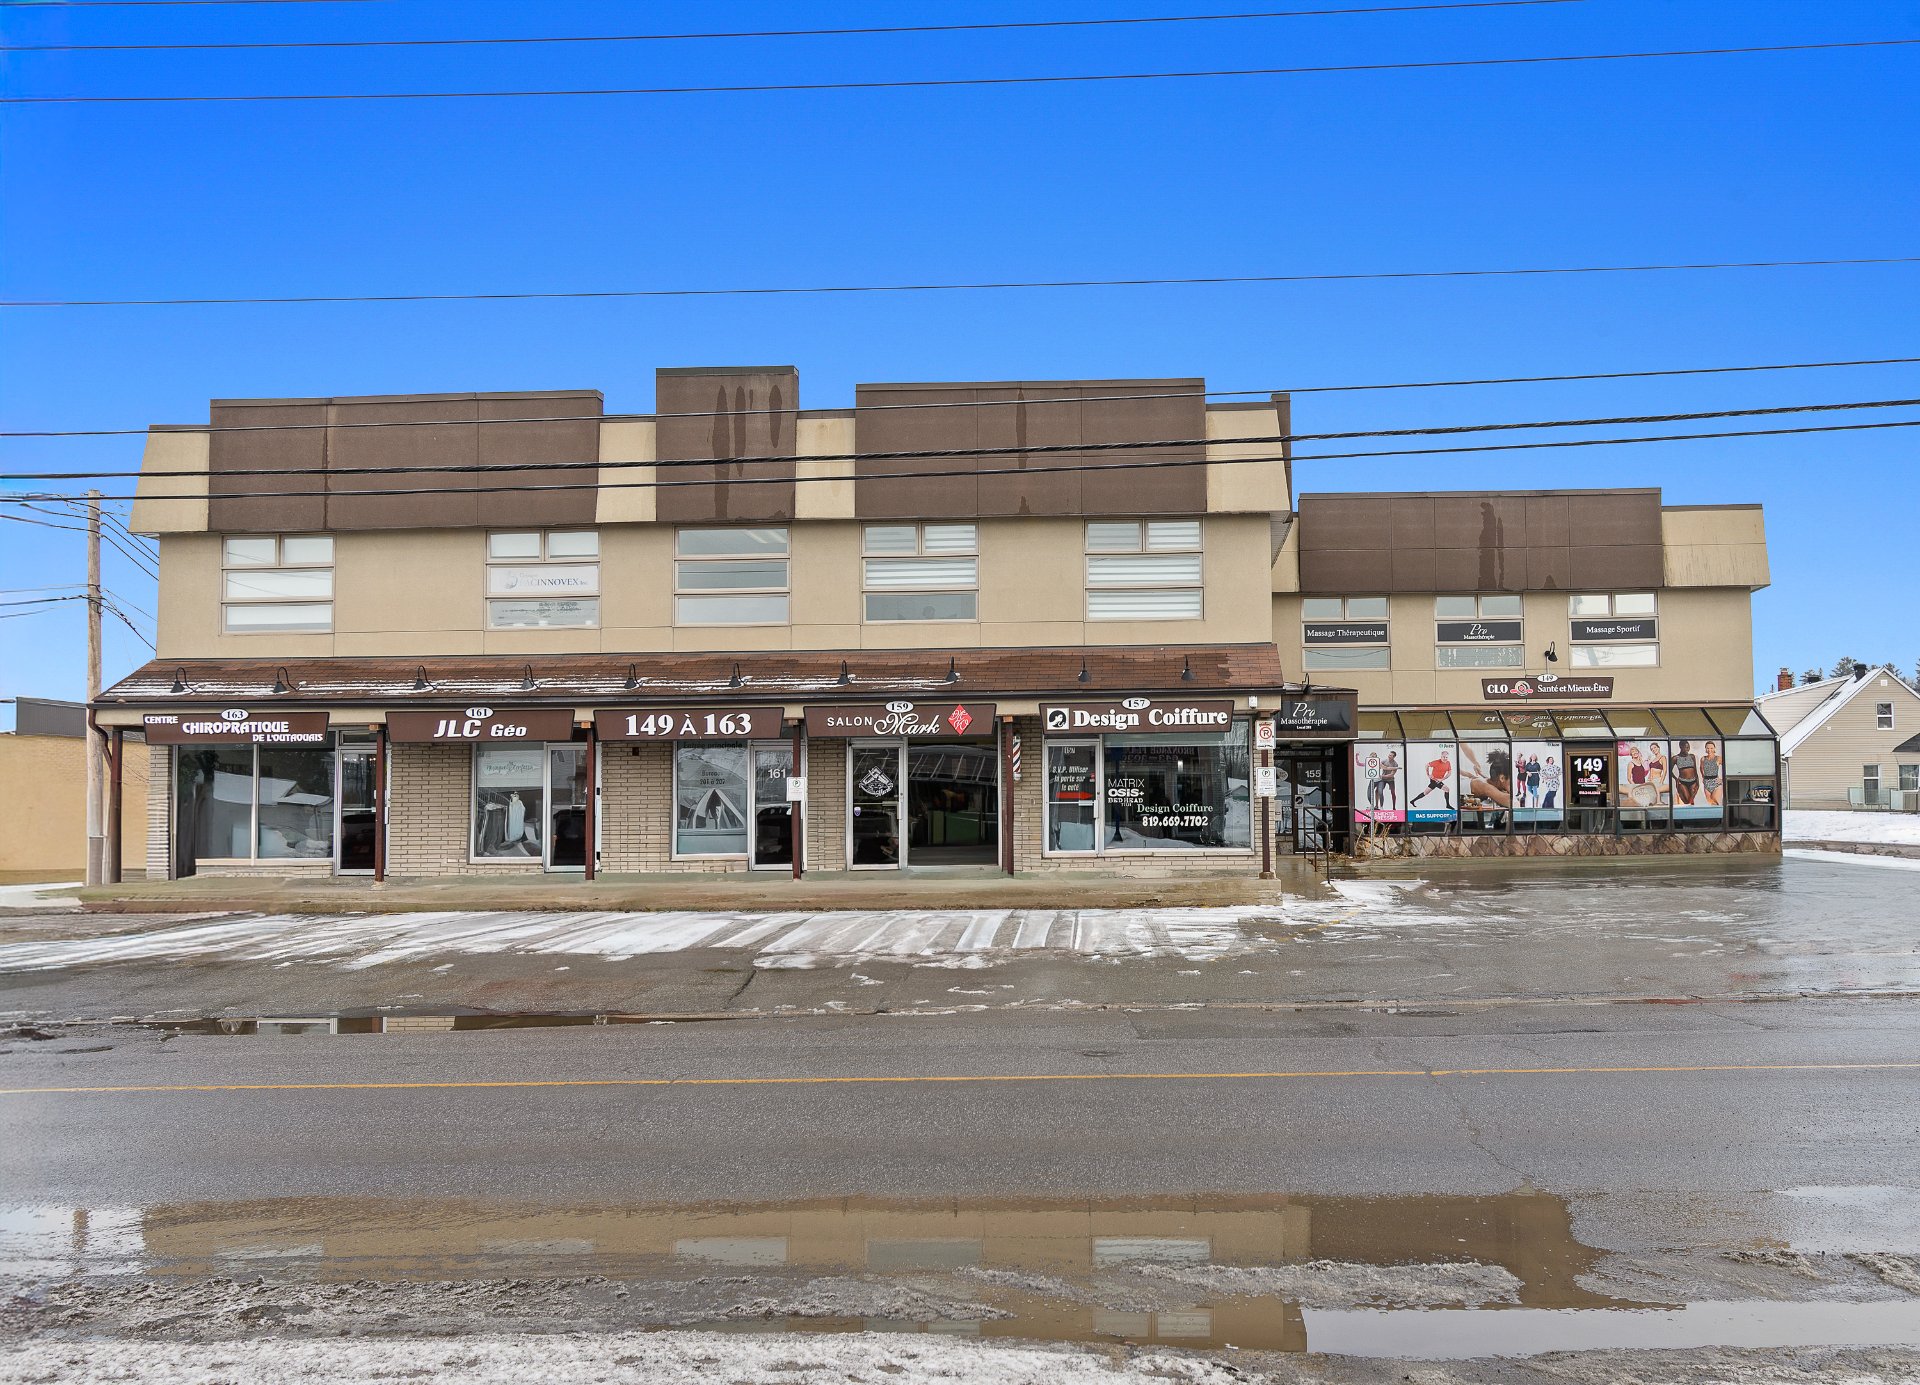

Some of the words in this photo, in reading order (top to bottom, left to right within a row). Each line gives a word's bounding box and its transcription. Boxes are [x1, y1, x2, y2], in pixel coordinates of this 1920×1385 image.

[1307, 629, 1335, 637] Massage
[1470, 623, 1488, 635] Pro
[1586, 626, 1615, 634] Massage
[1616, 625, 1641, 634] Sportif
[1487, 684, 1509, 694] CLO
[1537, 684, 1559, 693] Santé
[1567, 682, 1609, 692] Mieux-Être
[890, 703, 909, 711] 159
[1127, 700, 1145, 708] 157
[1292, 702, 1316, 717] Pro
[226, 710, 244, 719] 163
[471, 708, 488, 717] 161
[144, 716, 179, 724] CENTRE
[625, 714, 674, 736] 149
[679, 714, 697, 735] À
[703, 713, 752, 735] 163
[827, 717, 873, 727] SALON
[873, 712, 940, 735] Mark
[1073, 709, 1140, 730] Design
[1148, 708, 1228, 726] Coiffure
[1280, 717, 1328, 727] Massothérapie
[182, 721, 289, 735] CHIROPRATIQUE
[433, 719, 482, 738] JLC
[490, 724, 527, 737] Géo
[252, 734, 265, 742] DE
[266, 733, 323, 742] L'OUTAOUAIS
[1574, 758, 1603, 772] 149
[767, 768, 786, 779] 161
[1304, 769, 1321, 778] 155
[1107, 778, 1145, 788] MATRIX
[1136, 803, 1170, 814] Design
[1172, 803, 1214, 813] Coiffure
[1142, 816, 1209, 827] 819.669.7702
